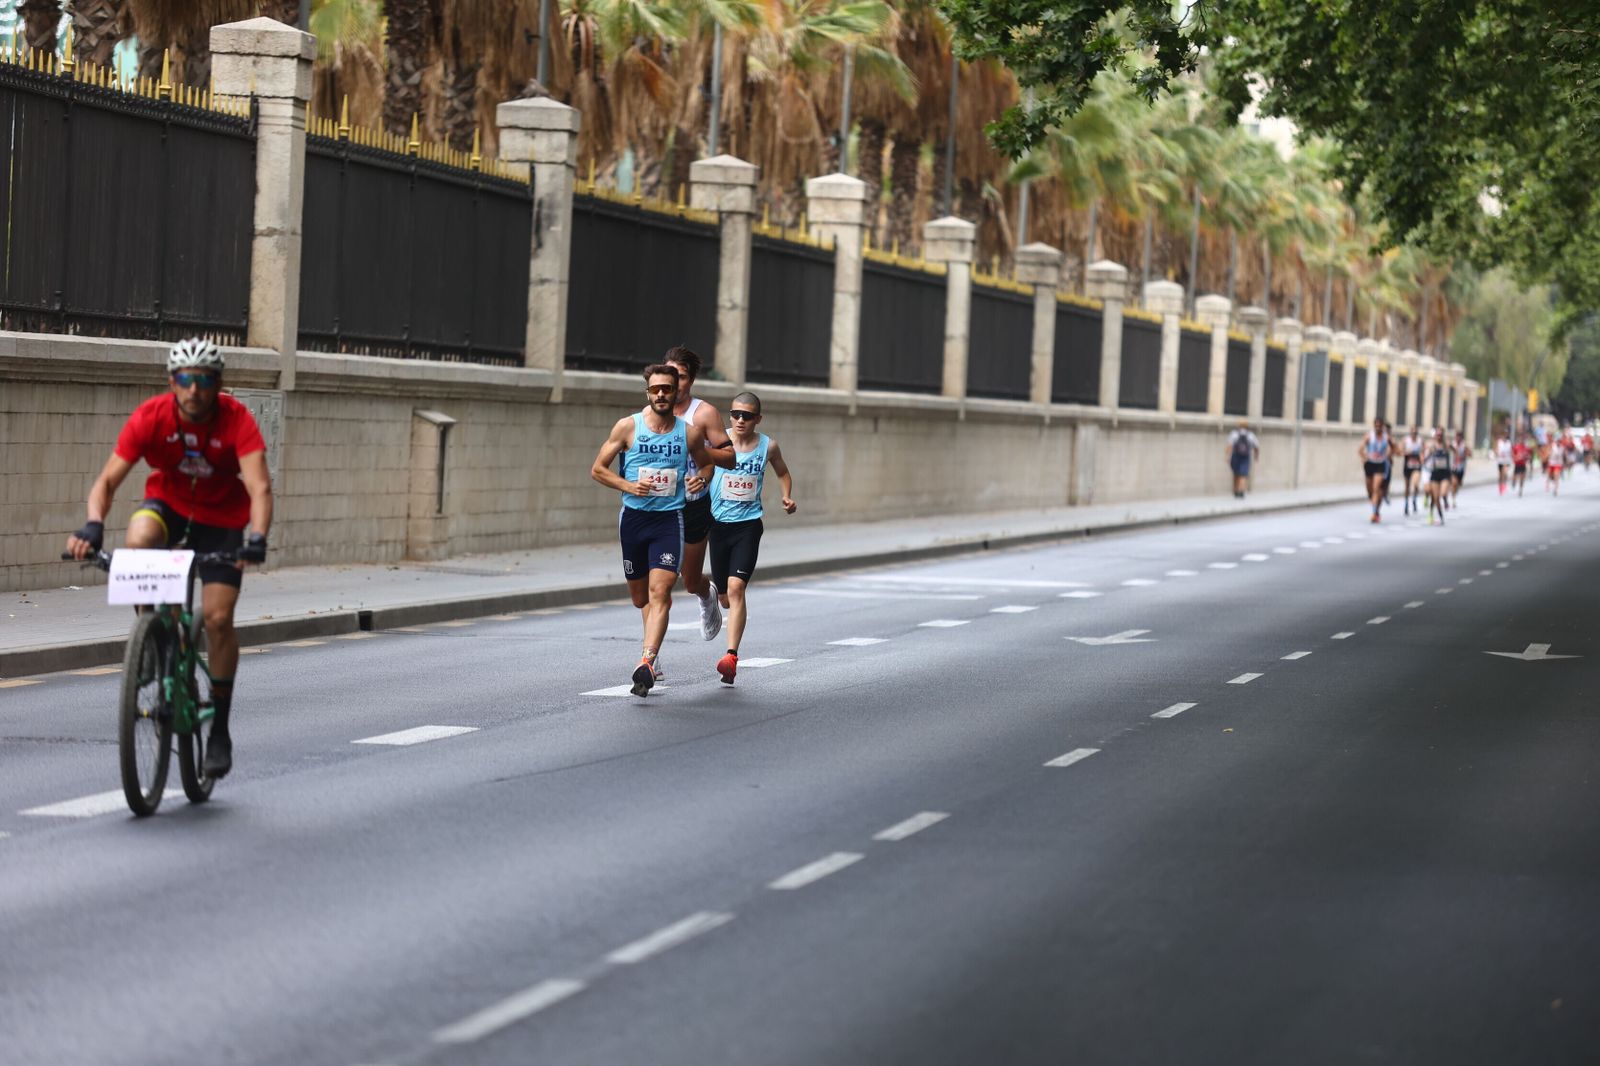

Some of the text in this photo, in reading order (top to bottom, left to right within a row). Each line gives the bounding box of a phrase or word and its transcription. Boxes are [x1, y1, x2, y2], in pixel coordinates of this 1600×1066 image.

[638, 441, 682, 457] nerja
[735, 460, 761, 474] erja
[727, 481, 753, 489] 1249
